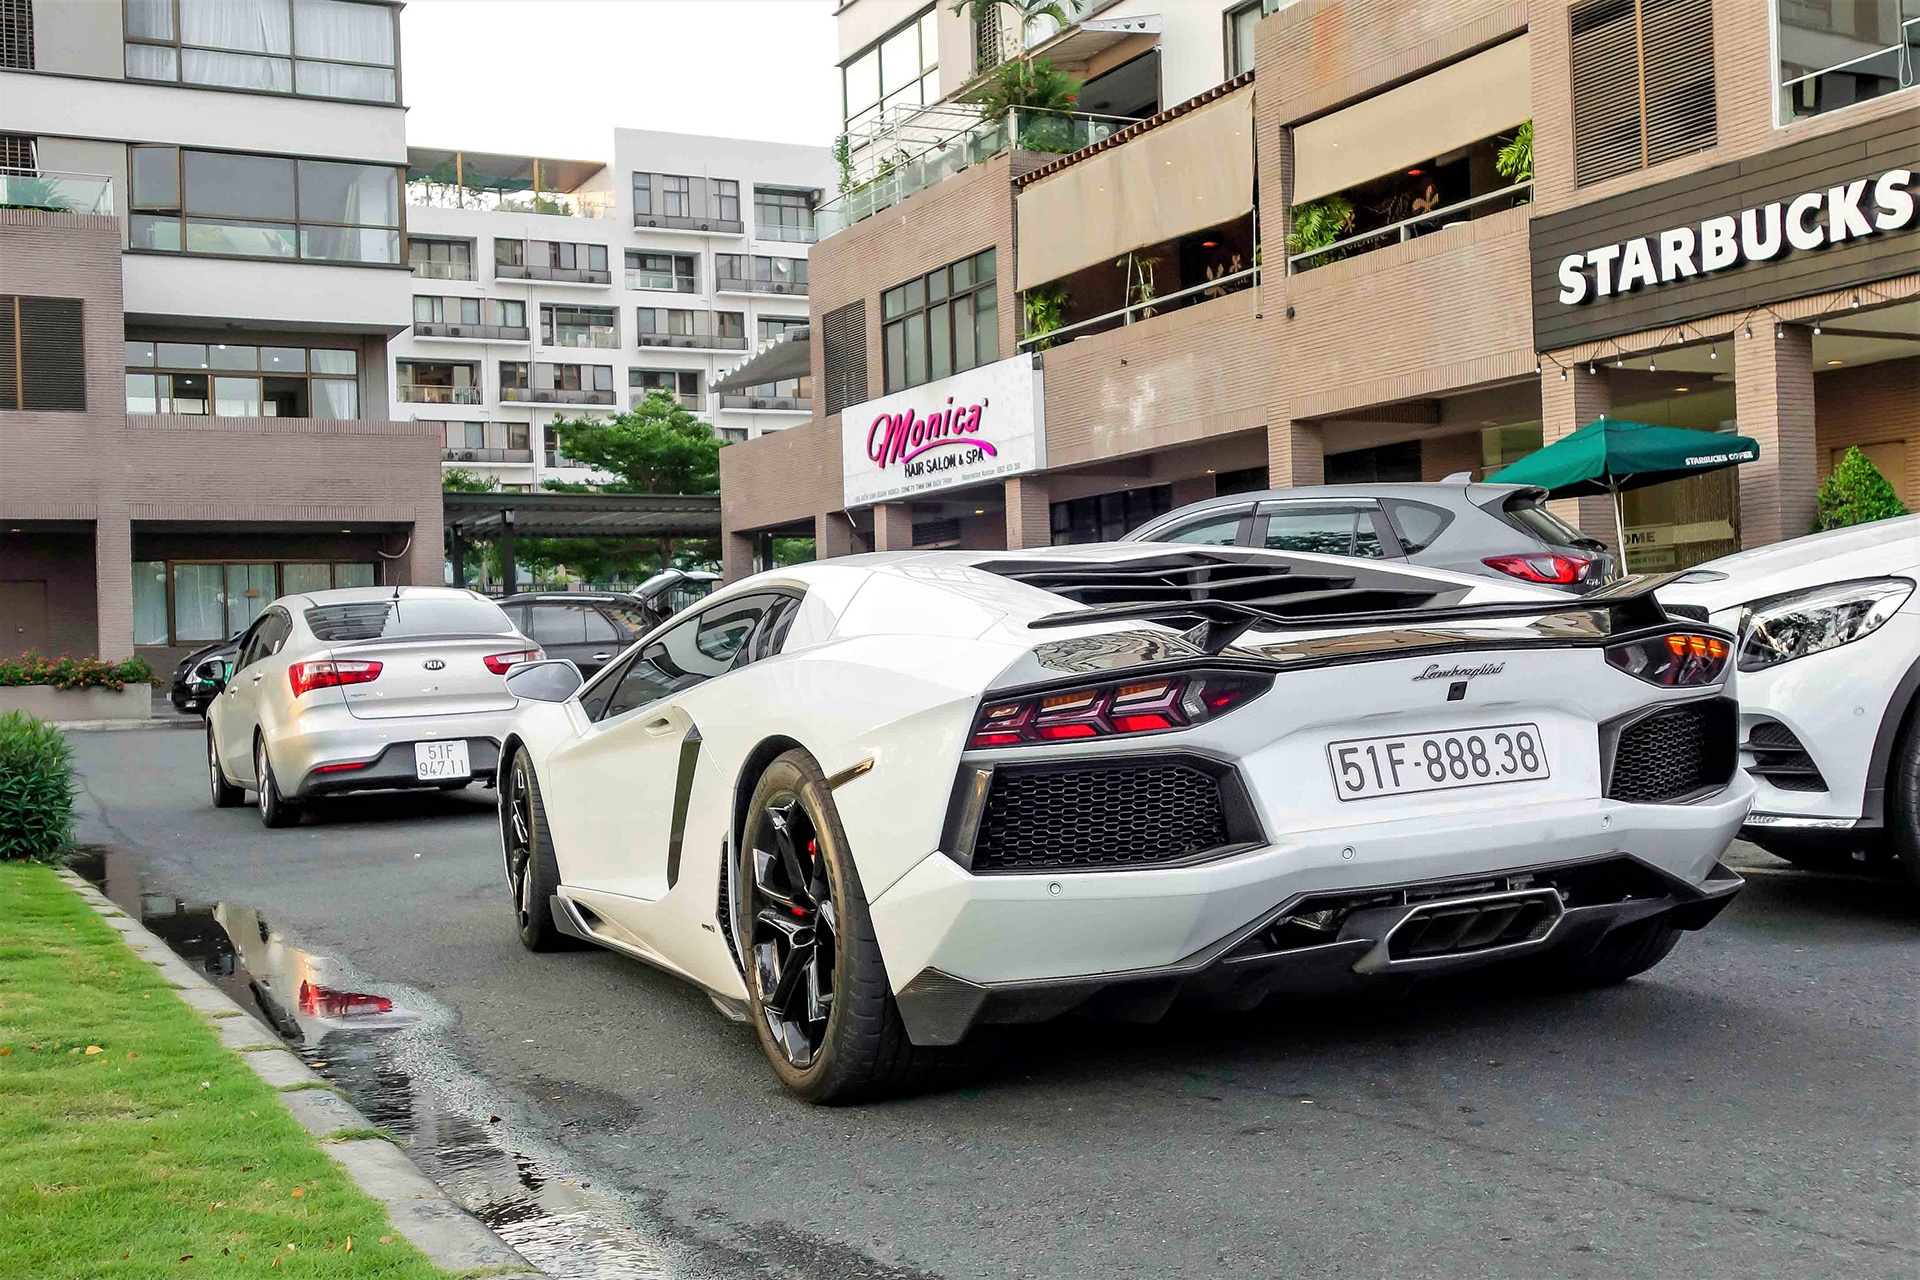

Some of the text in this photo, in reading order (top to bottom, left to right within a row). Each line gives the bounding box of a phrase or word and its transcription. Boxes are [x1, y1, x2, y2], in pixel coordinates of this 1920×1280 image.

[1558, 169, 1914, 305] STARBUCKS
[866, 396, 983, 469] Monica
[904, 447, 984, 478] HAIR SALON & SPA
[1685, 454, 1728, 466] STARBUCKS
[427, 660, 445, 670] KIA
[1412, 661, 1506, 682] Lamborghini
[428, 744, 454, 760] 51F
[1338, 731, 1539, 792] 51F-888.38
[419, 759, 466, 776] 947.11
